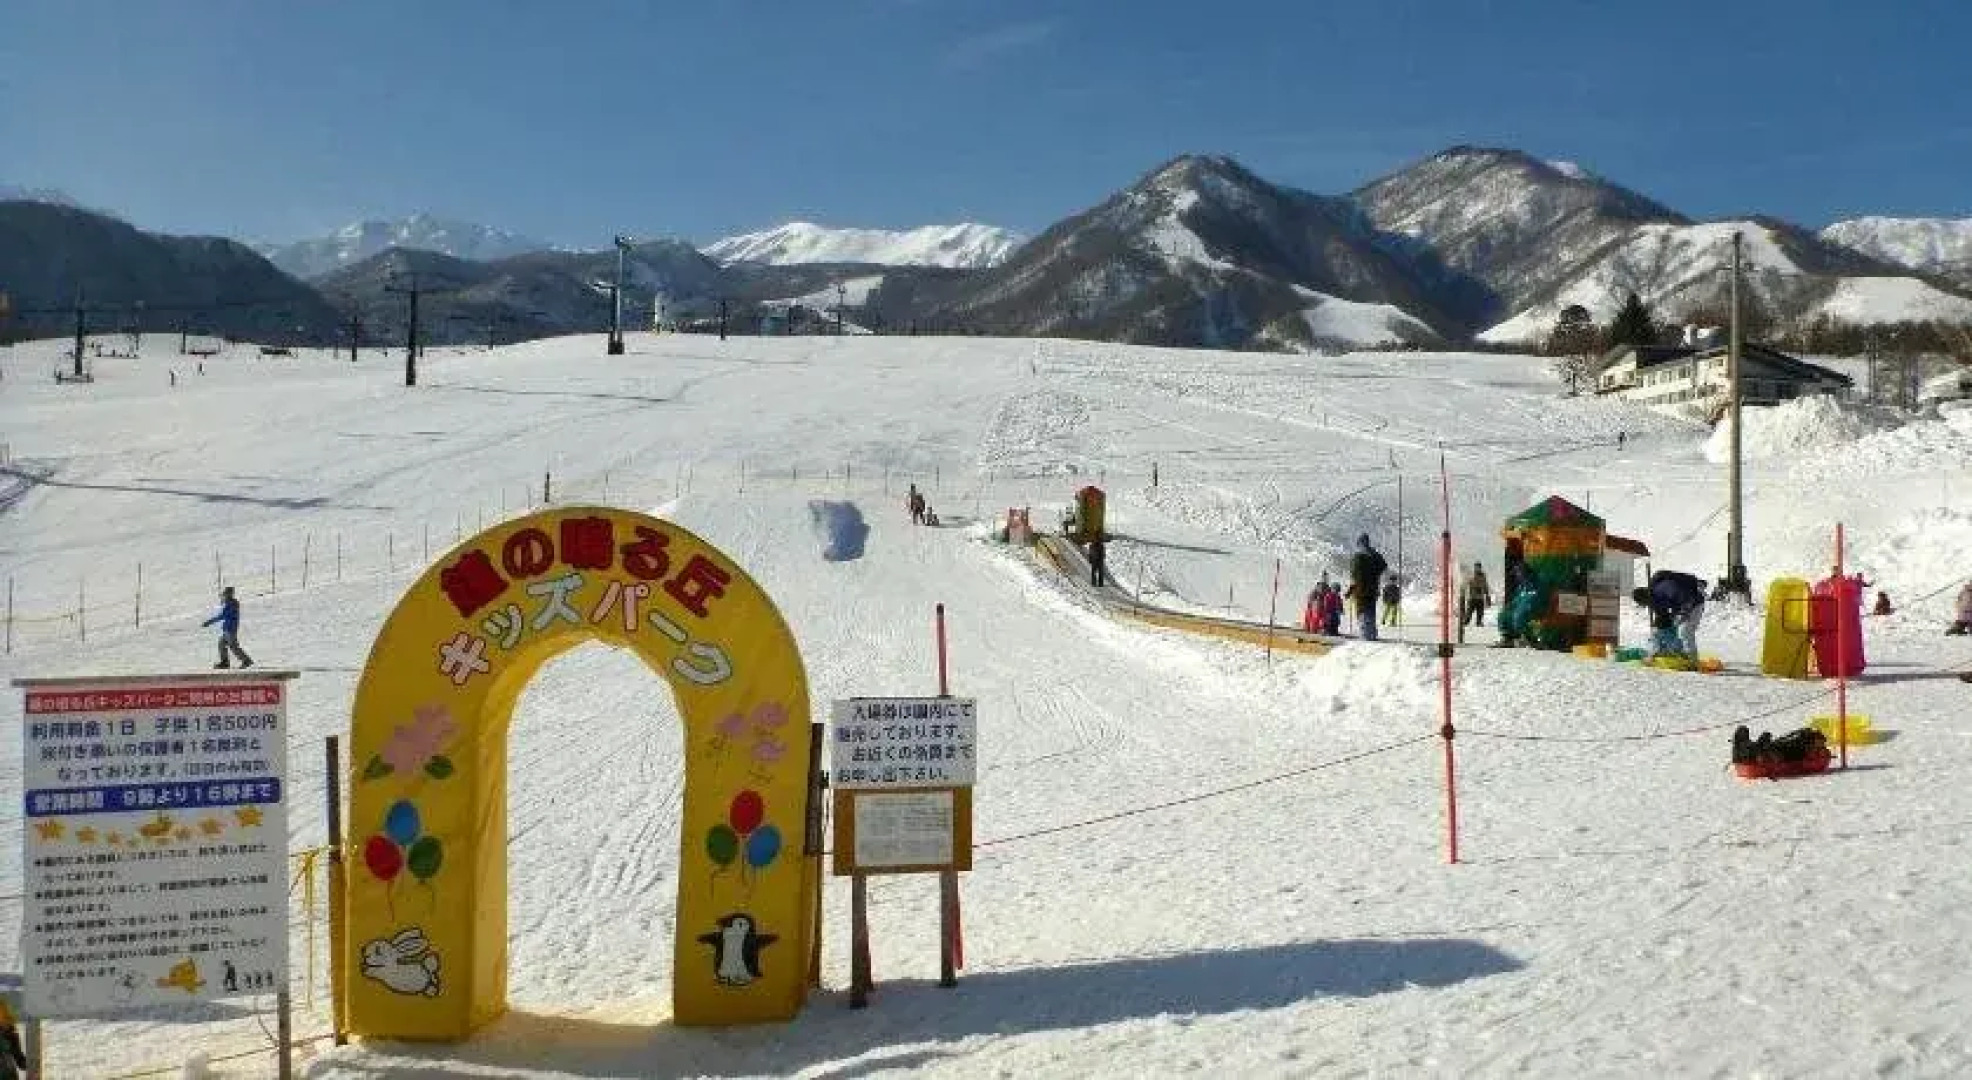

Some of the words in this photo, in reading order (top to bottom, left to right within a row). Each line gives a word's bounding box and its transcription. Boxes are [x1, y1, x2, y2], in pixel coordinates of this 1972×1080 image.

[439, 572, 732, 686] キッズパーク
[852, 703, 973, 721] 入場券は園内にて
[32, 719, 135, 739] 利用料金1日
[155, 713, 277, 734] 子供1名500円
[835, 724, 967, 743] 販売しております。
[836, 766, 949, 782] お申し出下さい。
[123, 783, 272, 805] 9時より16時まで
